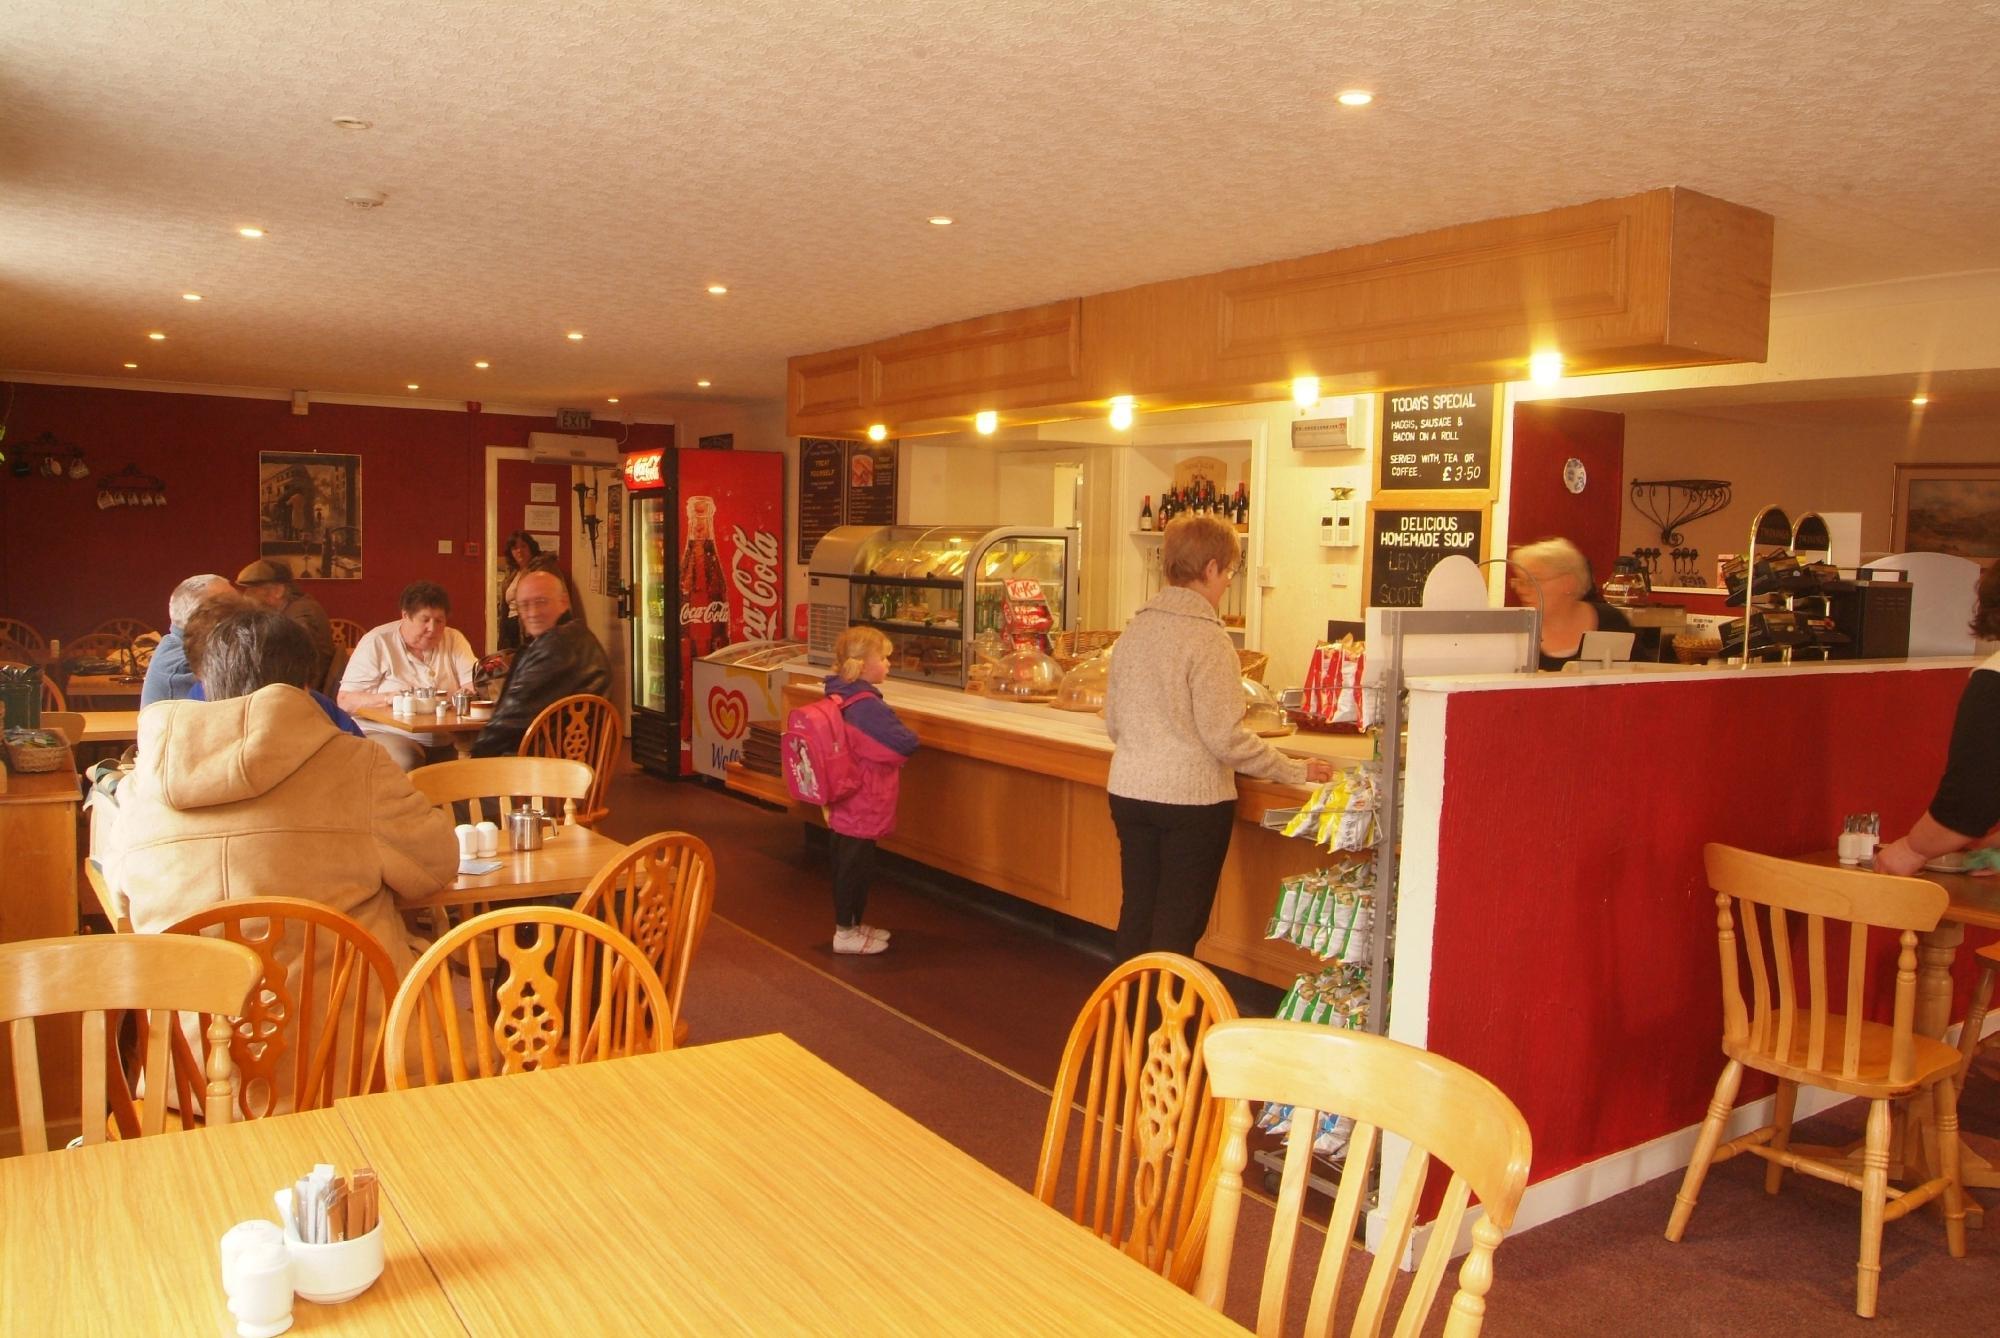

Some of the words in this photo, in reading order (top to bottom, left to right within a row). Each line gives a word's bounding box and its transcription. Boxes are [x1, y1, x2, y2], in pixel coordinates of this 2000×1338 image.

[1433, 392, 1477, 410] SPECIAL
[562, 414, 591, 428] EXIT
[1391, 419, 1418, 431] HAGGIS,
[1420, 416, 1452, 429] SAUSAGE
[1457, 416, 1464, 427] &
[1392, 431, 1416, 442] BACON
[1419, 431, 1429, 441] ON
[1431, 431, 1437, 440] A
[1440, 431, 1460, 440] ROLL
[1390, 453, 1417, 464] SERVED
[1444, 453, 1458, 463] TEA
[1464, 453, 1475, 463] OR
[1401, 516, 1458, 531] DELICIOUS
[1380, 532, 1440, 548] HOMEMADE
[1443, 532, 1475, 548] SOUP
[680, 601, 730, 625] Coca-Cola
